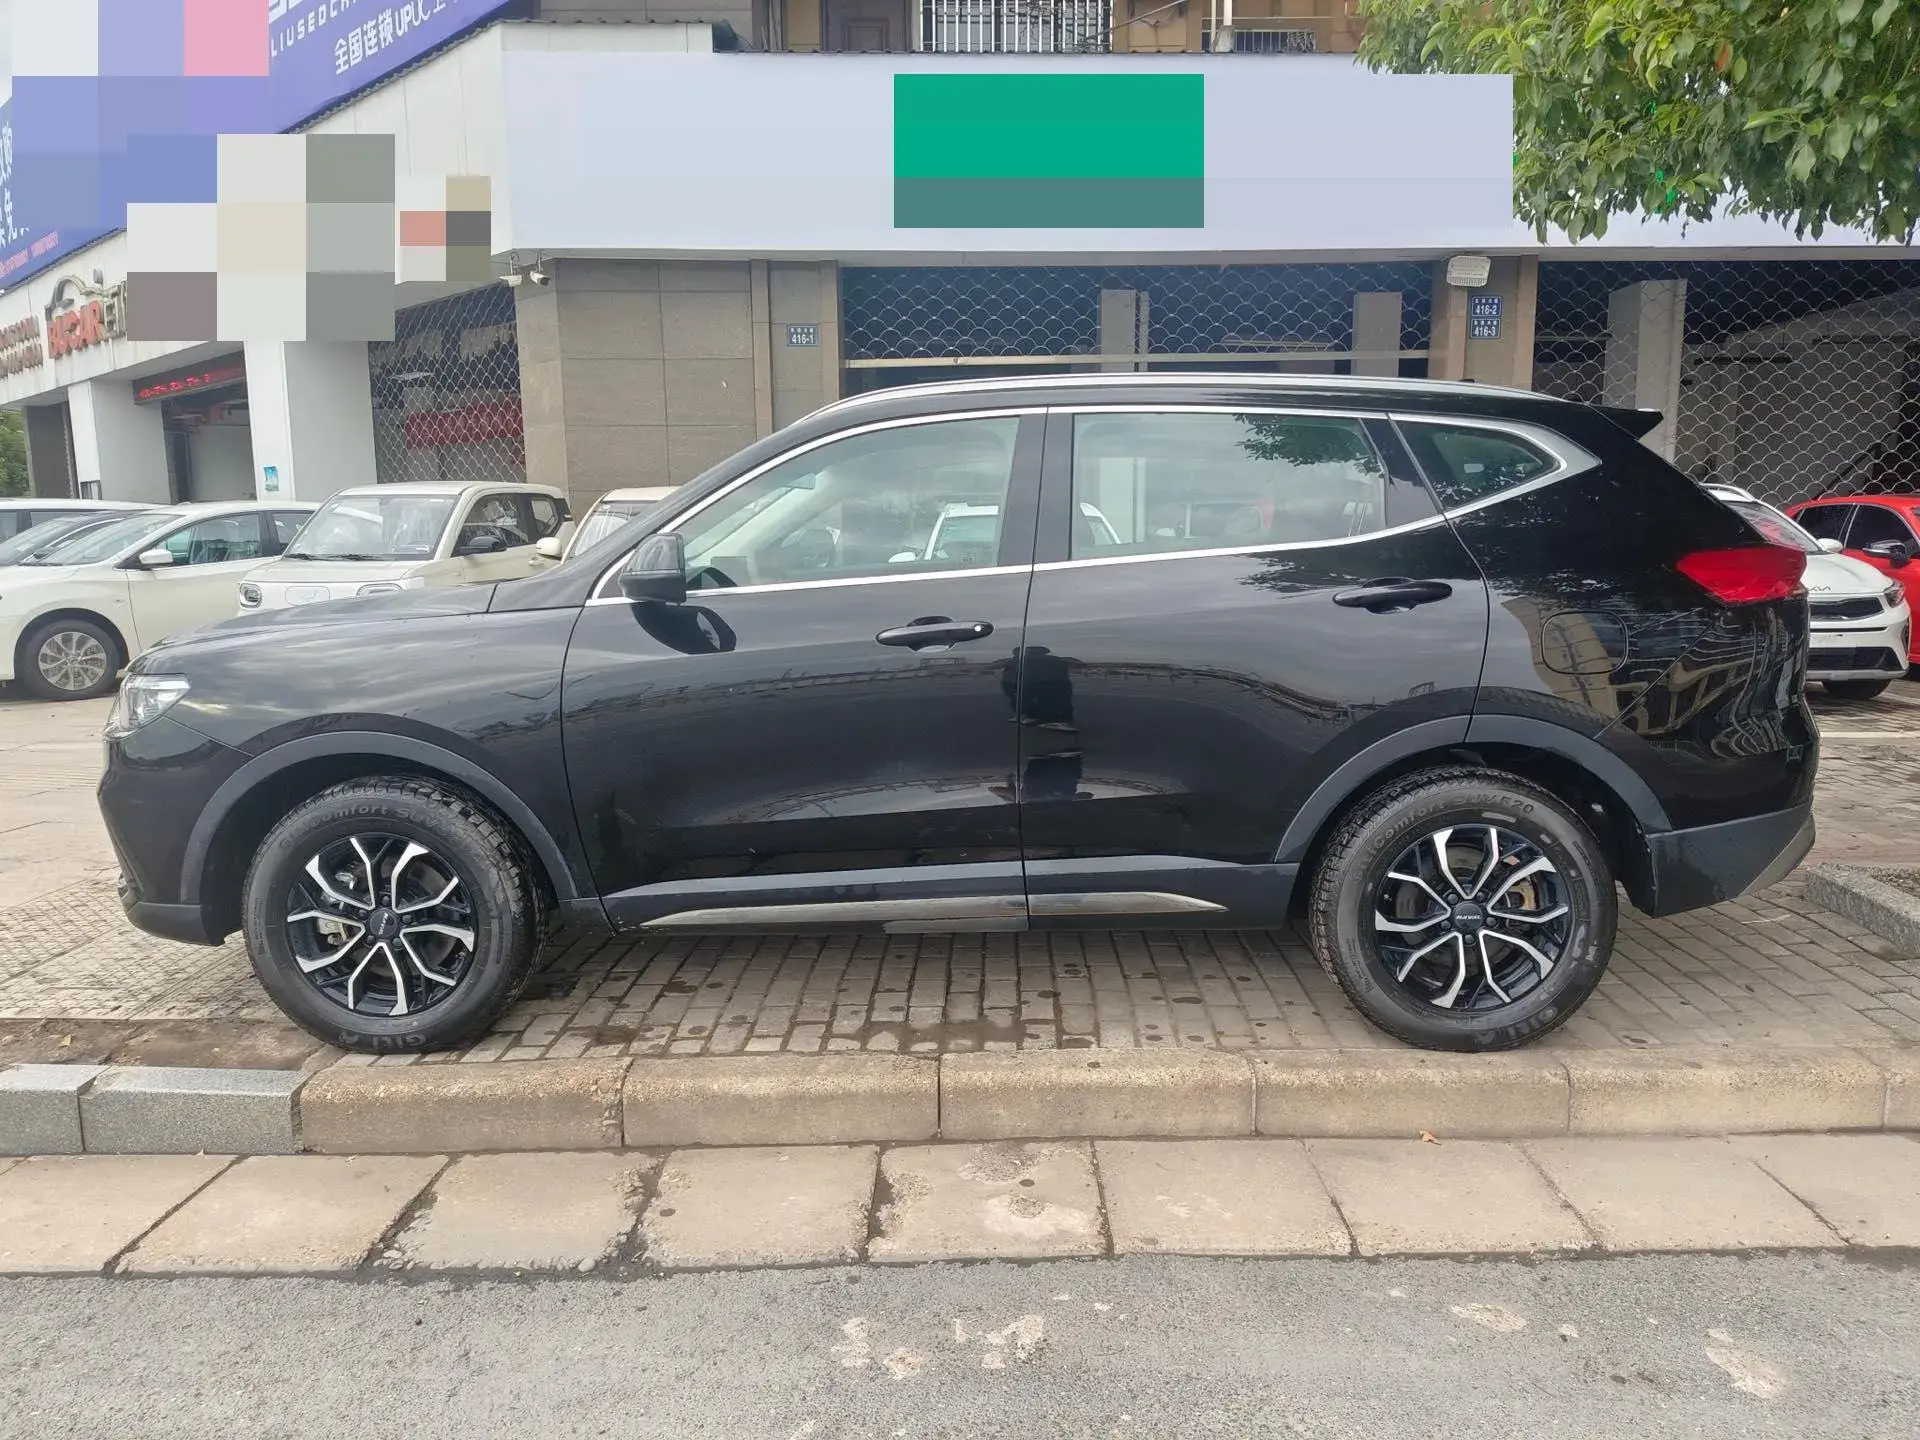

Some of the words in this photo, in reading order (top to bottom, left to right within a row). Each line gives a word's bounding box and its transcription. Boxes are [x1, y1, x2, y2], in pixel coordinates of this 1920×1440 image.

[1475, 304, 1497, 315] 416-2
[1474, 326, 1496, 337] 416-3
[791, 333, 814, 344] 416-1
